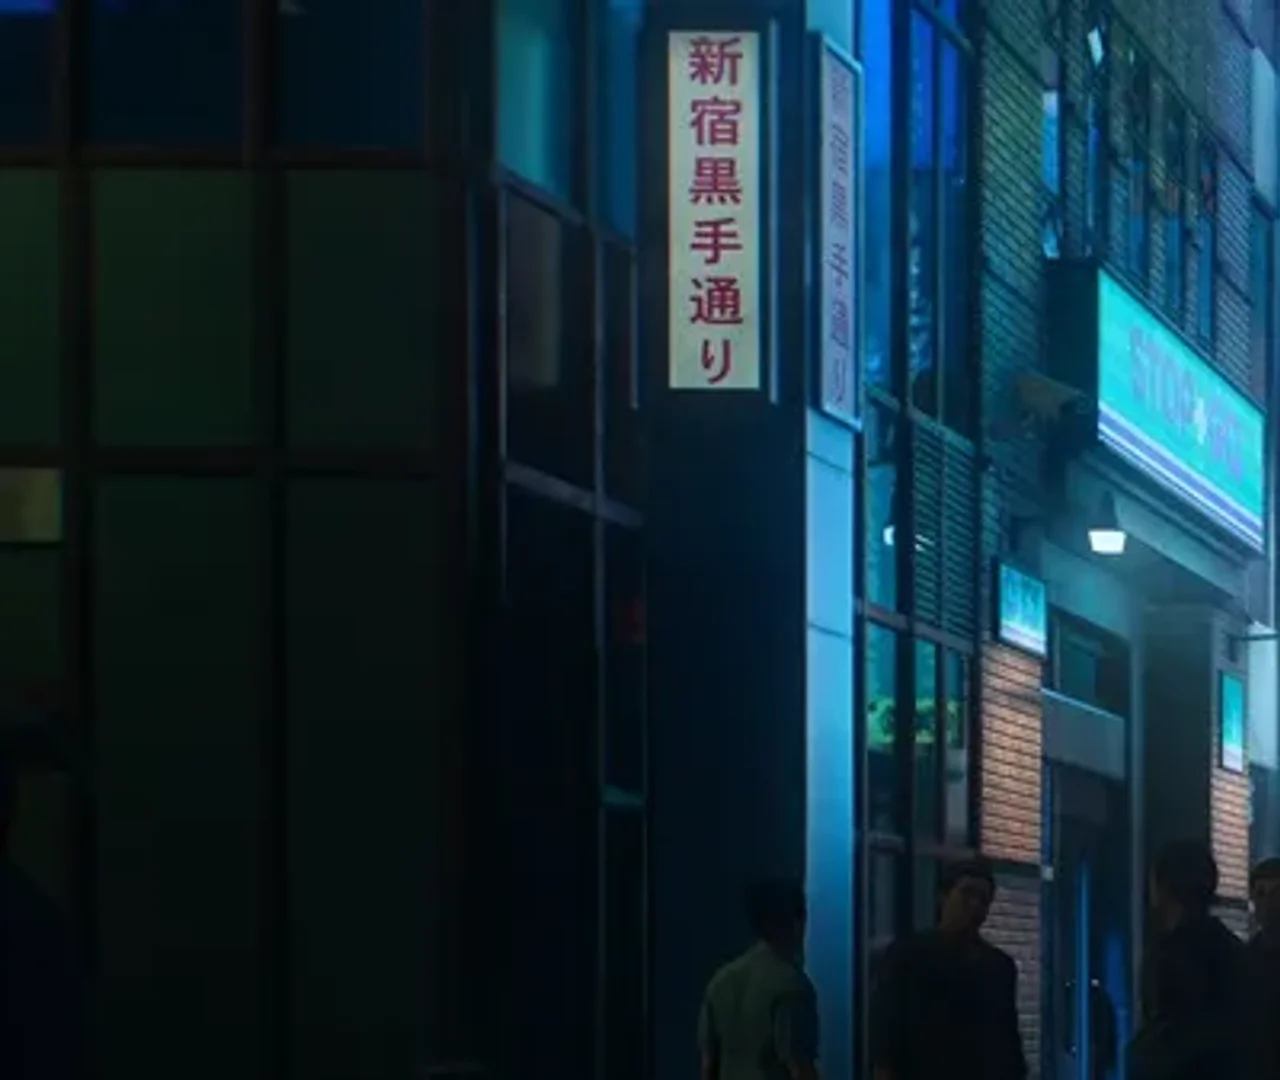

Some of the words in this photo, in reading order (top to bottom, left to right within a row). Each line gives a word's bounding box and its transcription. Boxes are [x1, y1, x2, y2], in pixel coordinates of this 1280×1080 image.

[689, 37, 743, 384] 新宿黒手通り
